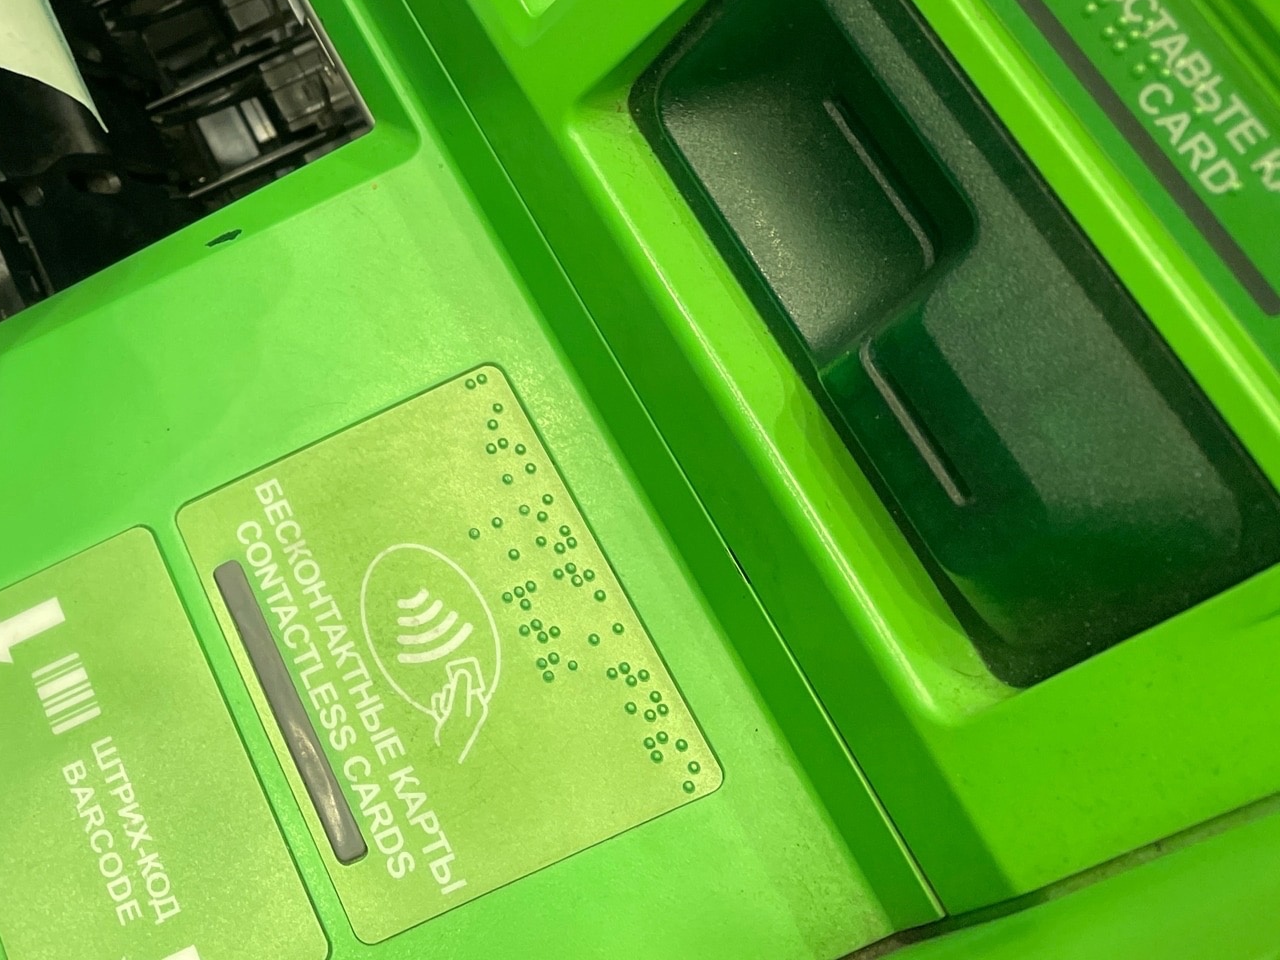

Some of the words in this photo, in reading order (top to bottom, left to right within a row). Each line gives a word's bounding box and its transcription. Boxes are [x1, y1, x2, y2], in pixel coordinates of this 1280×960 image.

[1138, 83, 1239, 194] CARD
[235, 520, 357, 752] CONTACTLESS
[343, 755, 416, 880] CARDS
[253, 477, 408, 765] БЕСКОНТАКТНЫЕ
[388, 765, 468, 896] КАРТЫ
[62, 760, 143, 927] BARCODE
[91, 736, 182, 926] ШТРИХ-КОД
